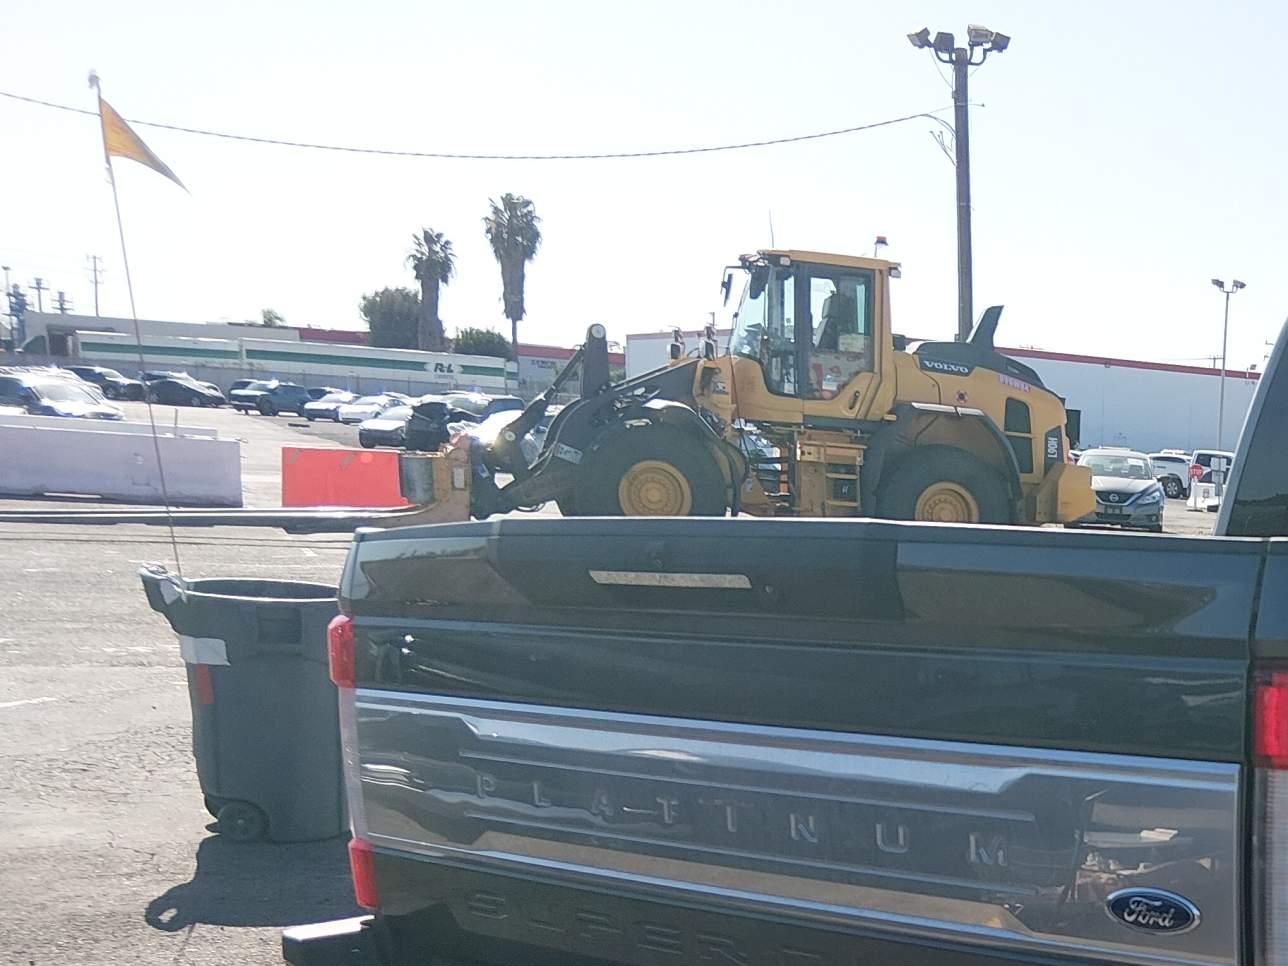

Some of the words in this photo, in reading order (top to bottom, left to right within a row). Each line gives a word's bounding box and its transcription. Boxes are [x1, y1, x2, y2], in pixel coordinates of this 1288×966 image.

[923, 360, 969, 374] VOLVO
[1047, 436, 1058, 458] L90H
[475, 774, 1008, 867] PLATINUM
[1123, 896, 1176, 928] Ford
